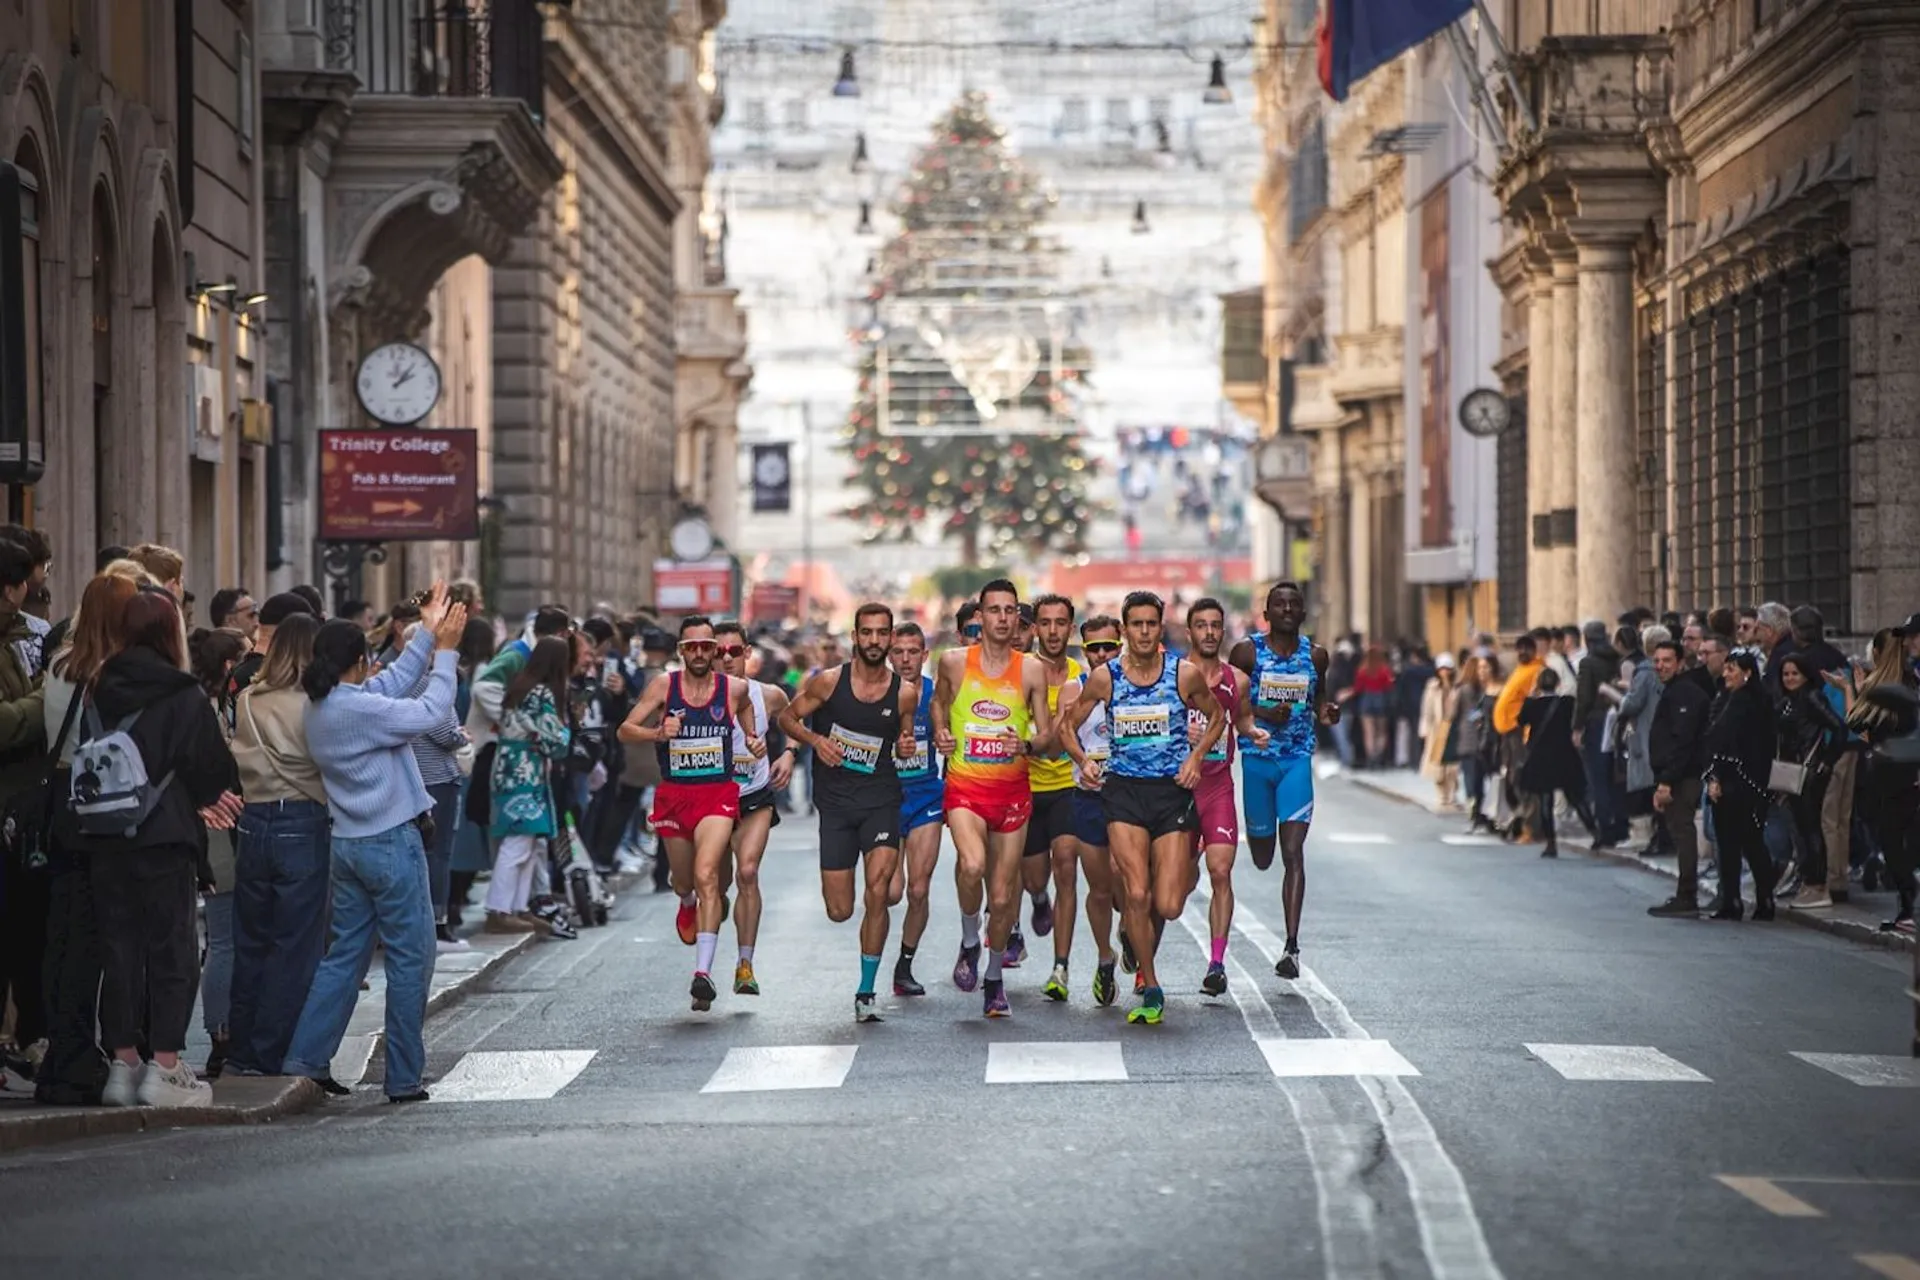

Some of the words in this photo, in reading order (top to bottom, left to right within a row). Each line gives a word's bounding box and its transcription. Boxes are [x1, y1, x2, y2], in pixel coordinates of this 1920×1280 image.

[330, 438, 386, 454] Trinity
[390, 438, 449, 454] College
[352, 473, 376, 485] Pub
[378, 473, 389, 485] &
[392, 473, 456, 485] Restaurant
[1122, 720, 1160, 735] MEUCCI
[975, 741, 1003, 754] 2419
[680, 754, 690, 767] LA
[692, 752, 715, 767] ROSA
